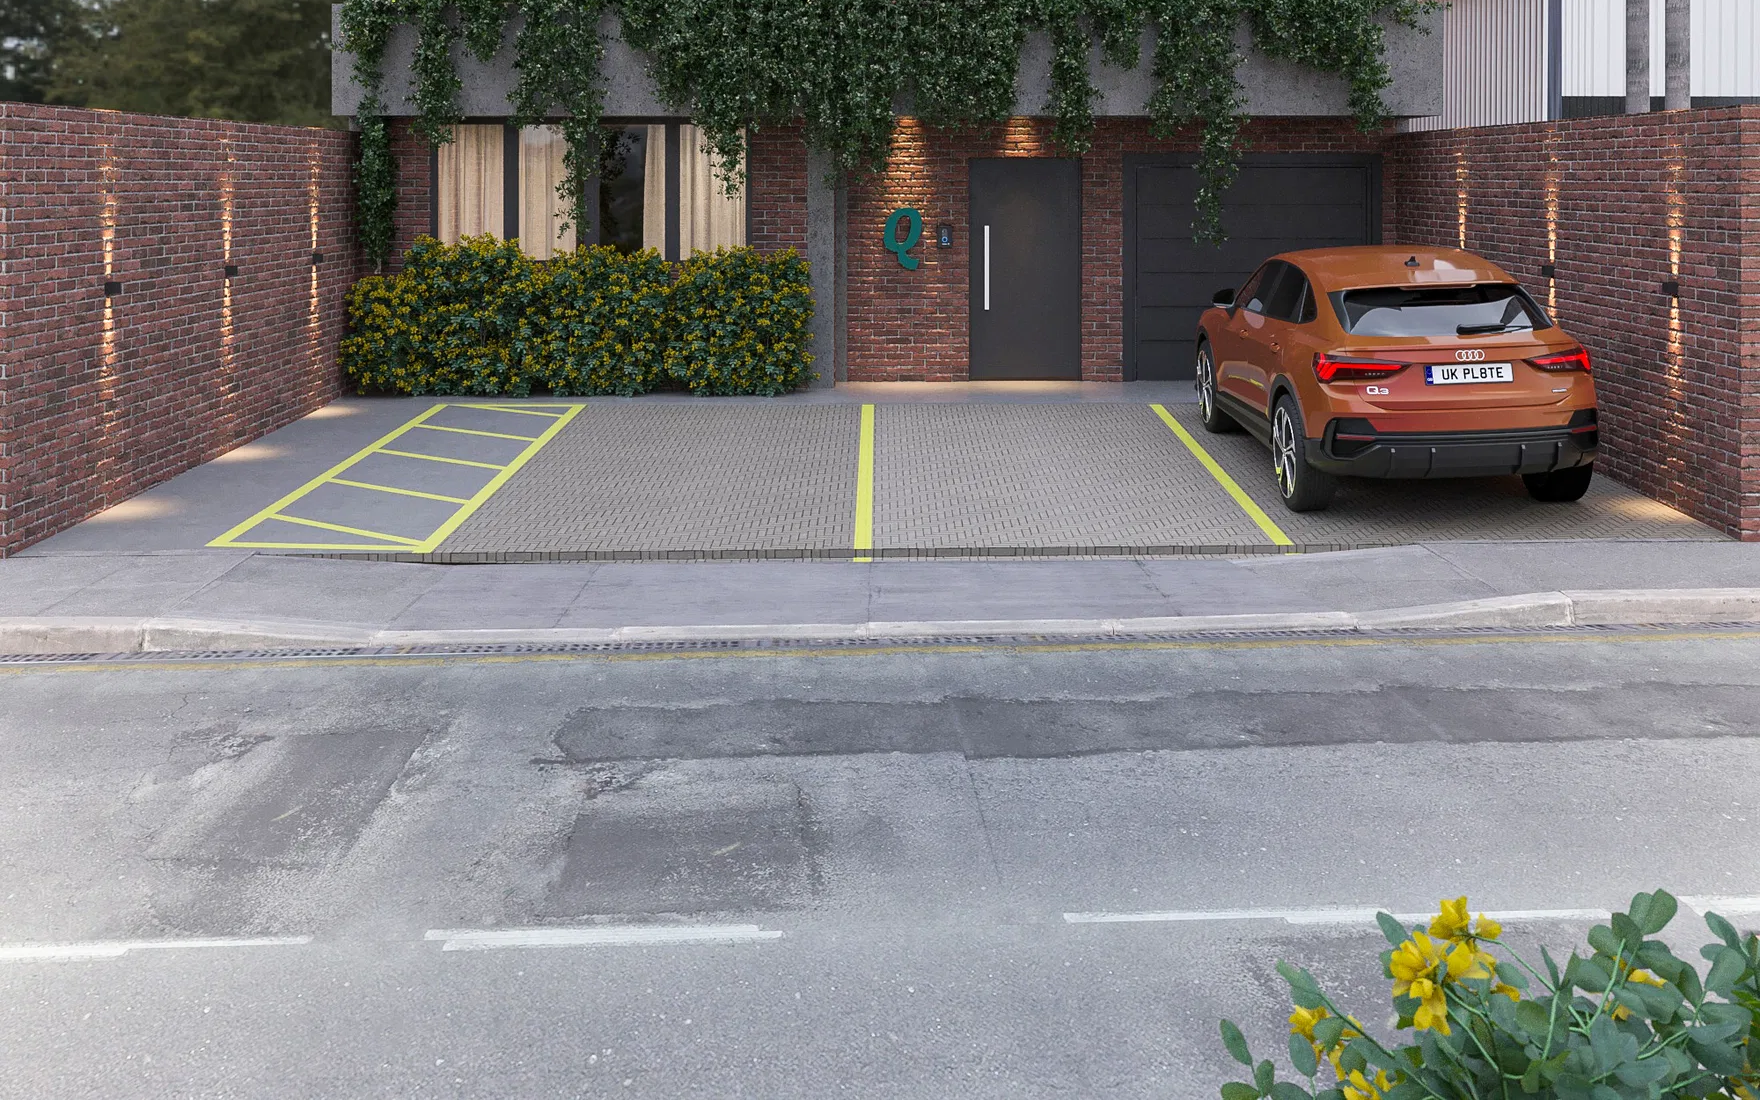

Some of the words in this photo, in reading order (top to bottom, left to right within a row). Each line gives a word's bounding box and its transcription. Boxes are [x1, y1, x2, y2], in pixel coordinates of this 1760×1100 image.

[883, 207, 923, 271] Q
[1441, 368, 1459, 380] UK
[1463, 366, 1504, 380] PL8TE
[1366, 386, 1389, 395] Q3
